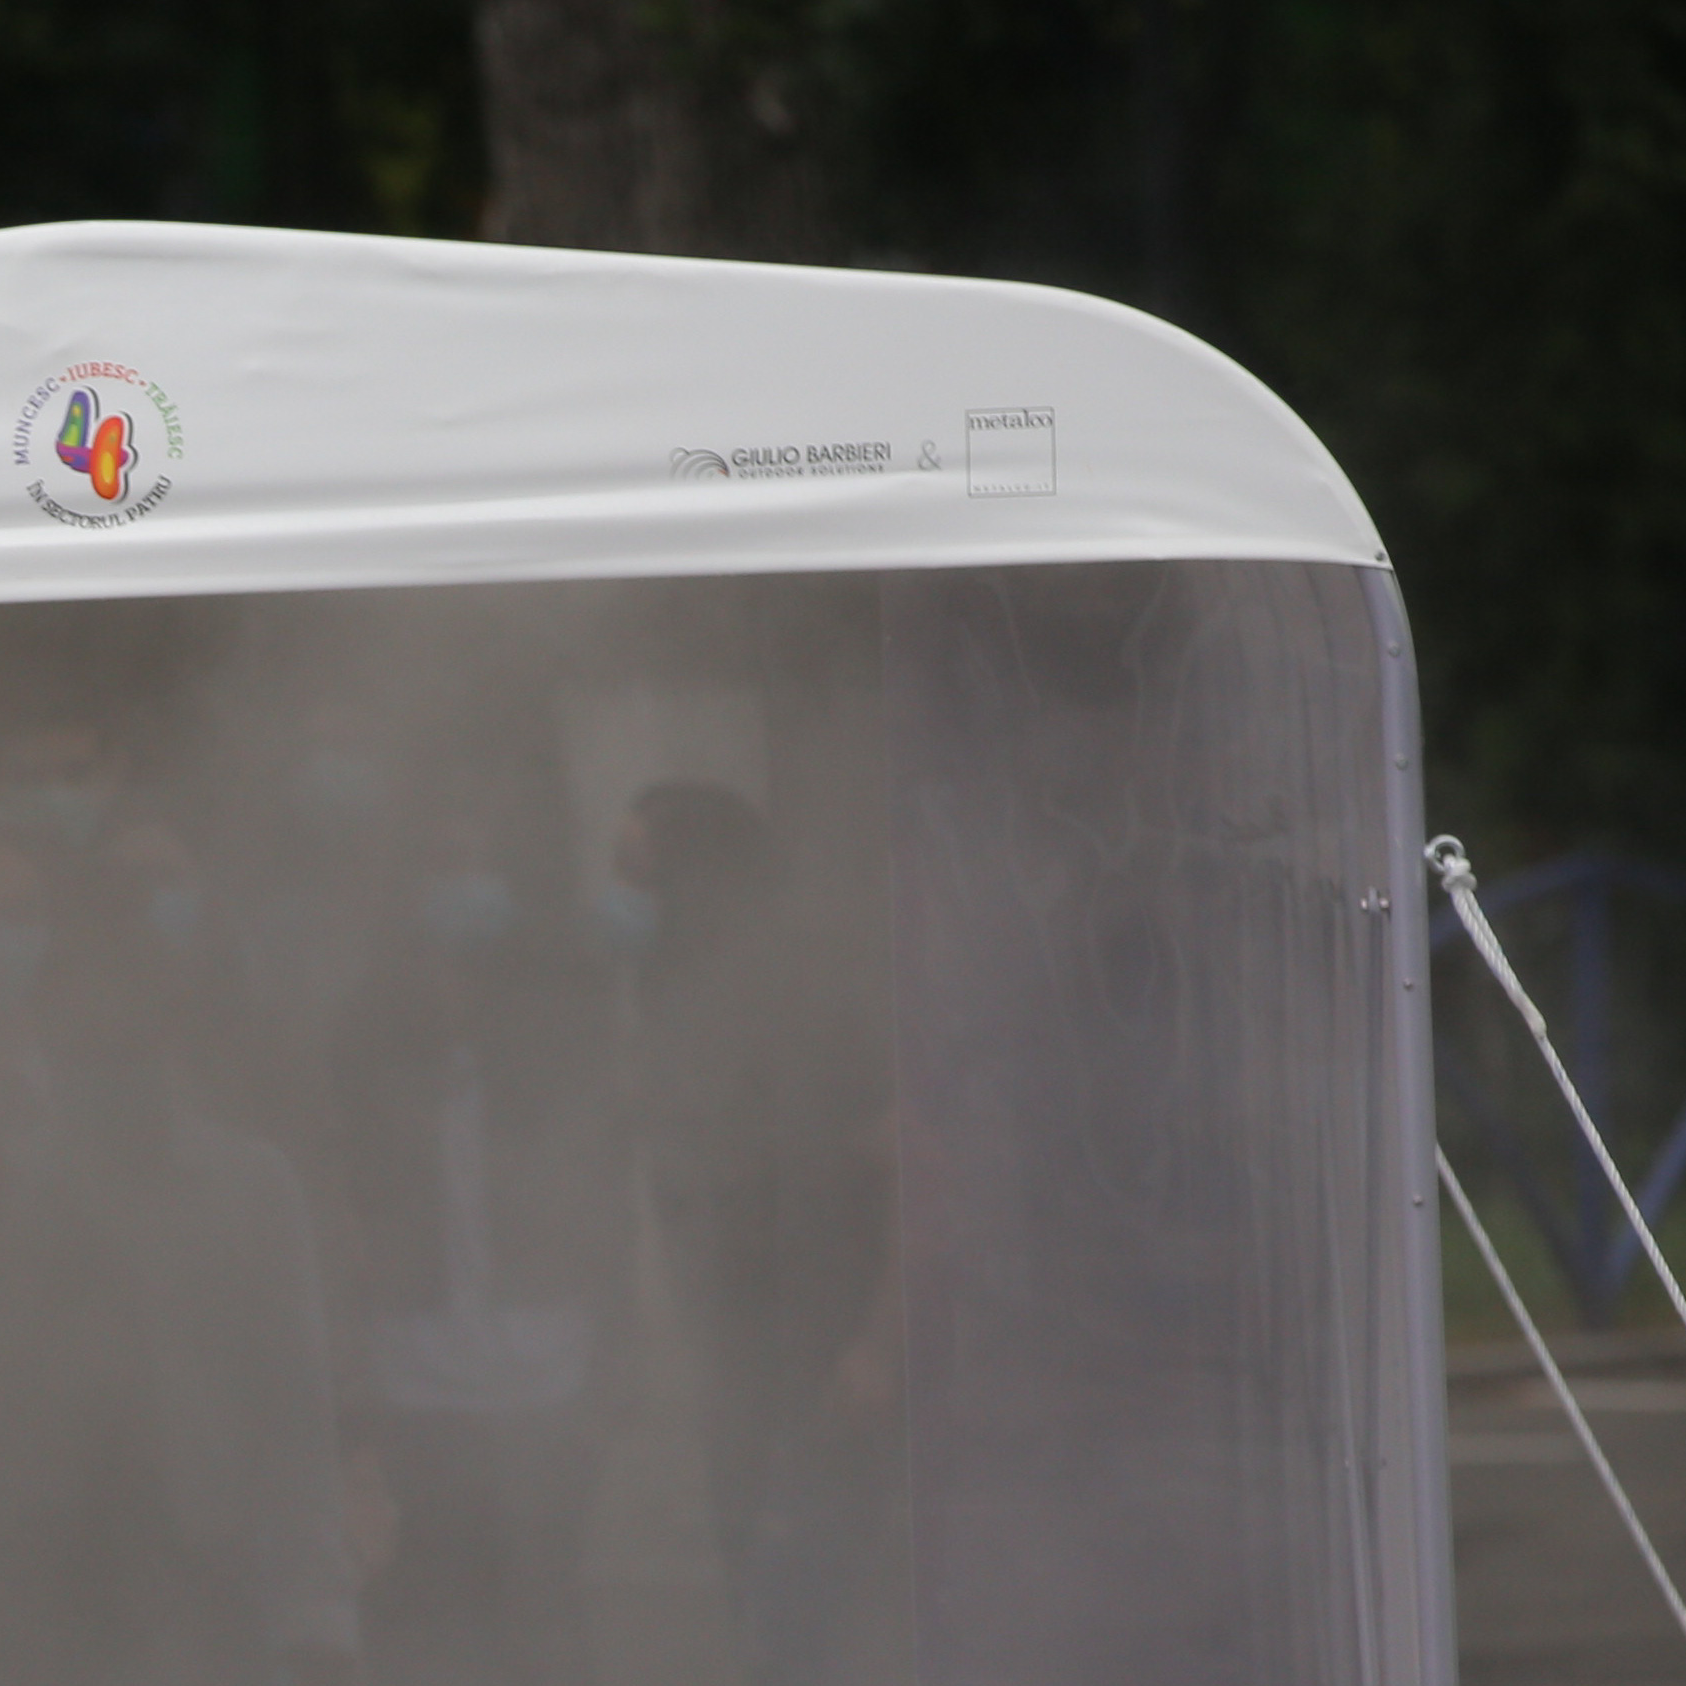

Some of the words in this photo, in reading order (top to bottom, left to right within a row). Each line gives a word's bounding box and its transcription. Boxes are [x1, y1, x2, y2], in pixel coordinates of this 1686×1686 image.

[64, 361, 139, 384] IUBESC
[731, 445, 801, 468] GIULIO
[806, 442, 892, 465] BARBIERI
[40, 498, 126, 530] SECTORUL
